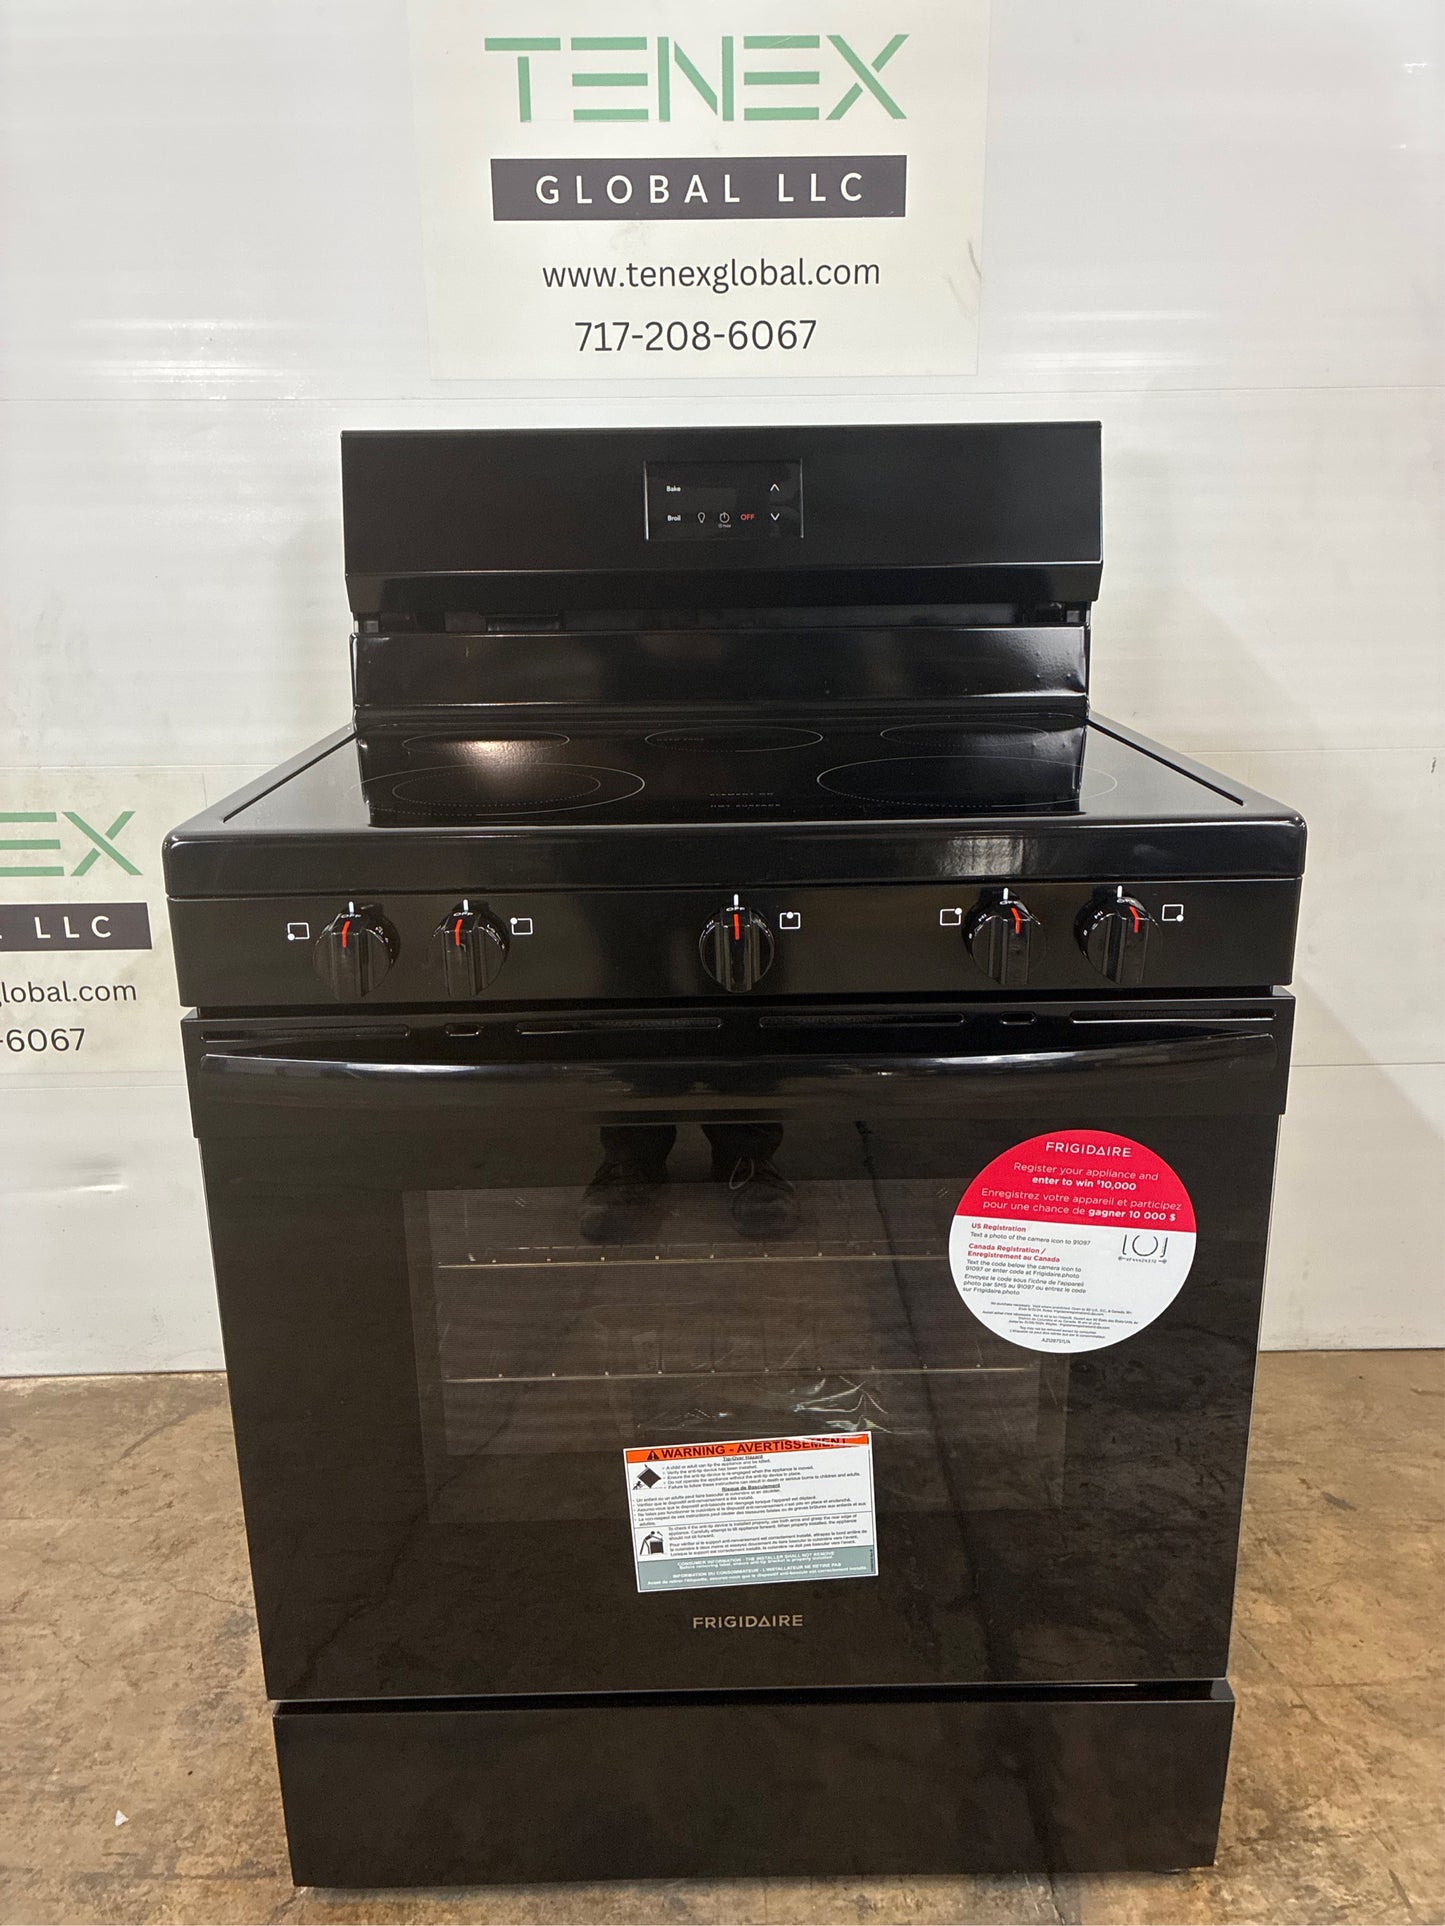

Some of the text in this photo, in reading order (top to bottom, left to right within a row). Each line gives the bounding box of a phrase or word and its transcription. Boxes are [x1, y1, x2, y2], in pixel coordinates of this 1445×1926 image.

[484, 34, 910, 122] TENEX
[535, 172, 864, 204] GLOBAL LLC
[542, 258, 881, 294] www.tenexglobal.com
[574, 320, 817, 351] 717-208-6067
[34, 915, 112, 940] LLC
[0, 979, 137, 1008] lobal.com
[1045, 1141, 1131, 1158] FRIGIDAIRE
[1013, 1161, 1158, 1181] Register your appliance and
[1032, 1175, 1136, 1192] enter to win $10,000
[981, 1187, 1181, 1213] Enregistrez votre appareil et participez
[983, 1201, 1007, 1211] pour
[1032, 1202, 1069, 1213] chance
[1072, 1205, 1085, 1214] de
[1088, 1209, 1125, 1220] gagner
[1128, 1210, 1140, 1219] 10
[1143, 1211, 1166, 1221] 000
[1169, 1213, 1175, 1224] $
[983, 1223, 1026, 1233] Registration
[989, 1232, 1007, 1240] photo
[967, 1250, 1021, 1260] Enregistrement
[968, 1242, 995, 1250] Canada
[996, 1244, 1039, 1255] Registration
[661, 1445, 725, 1458] WARNING
[693, 1614, 803, 1629] FRIGIDAIRE
